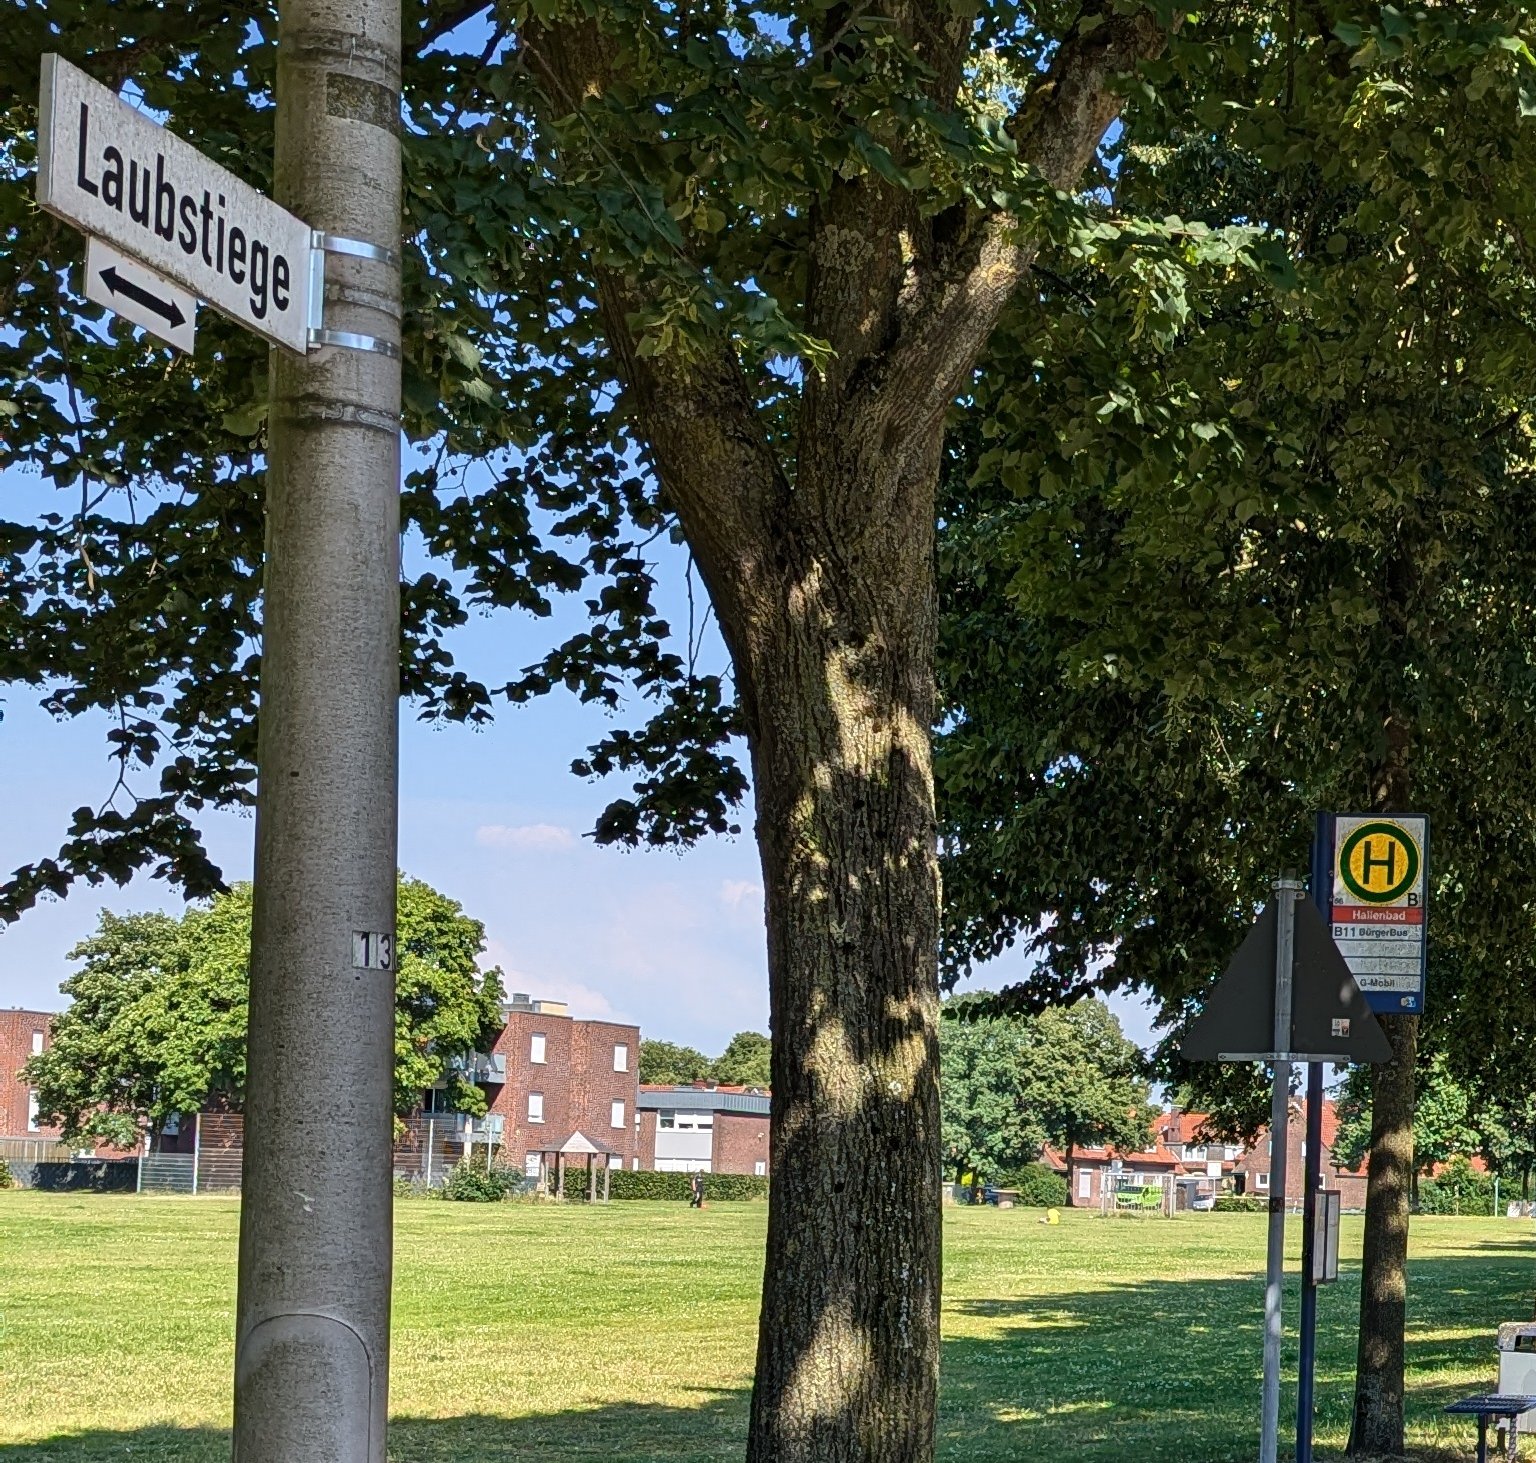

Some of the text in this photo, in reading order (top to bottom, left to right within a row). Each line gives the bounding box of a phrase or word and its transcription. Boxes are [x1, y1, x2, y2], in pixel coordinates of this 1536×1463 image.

[77, 101, 290, 319] Laubstiege
[1363, 840, 1396, 886] H
[1407, 892, 1418, 907] B
[1352, 909, 1406, 921] Hallenbad
[1334, 926, 1408, 939] B11 BürgerBus
[361, 932, 391, 969] 13
